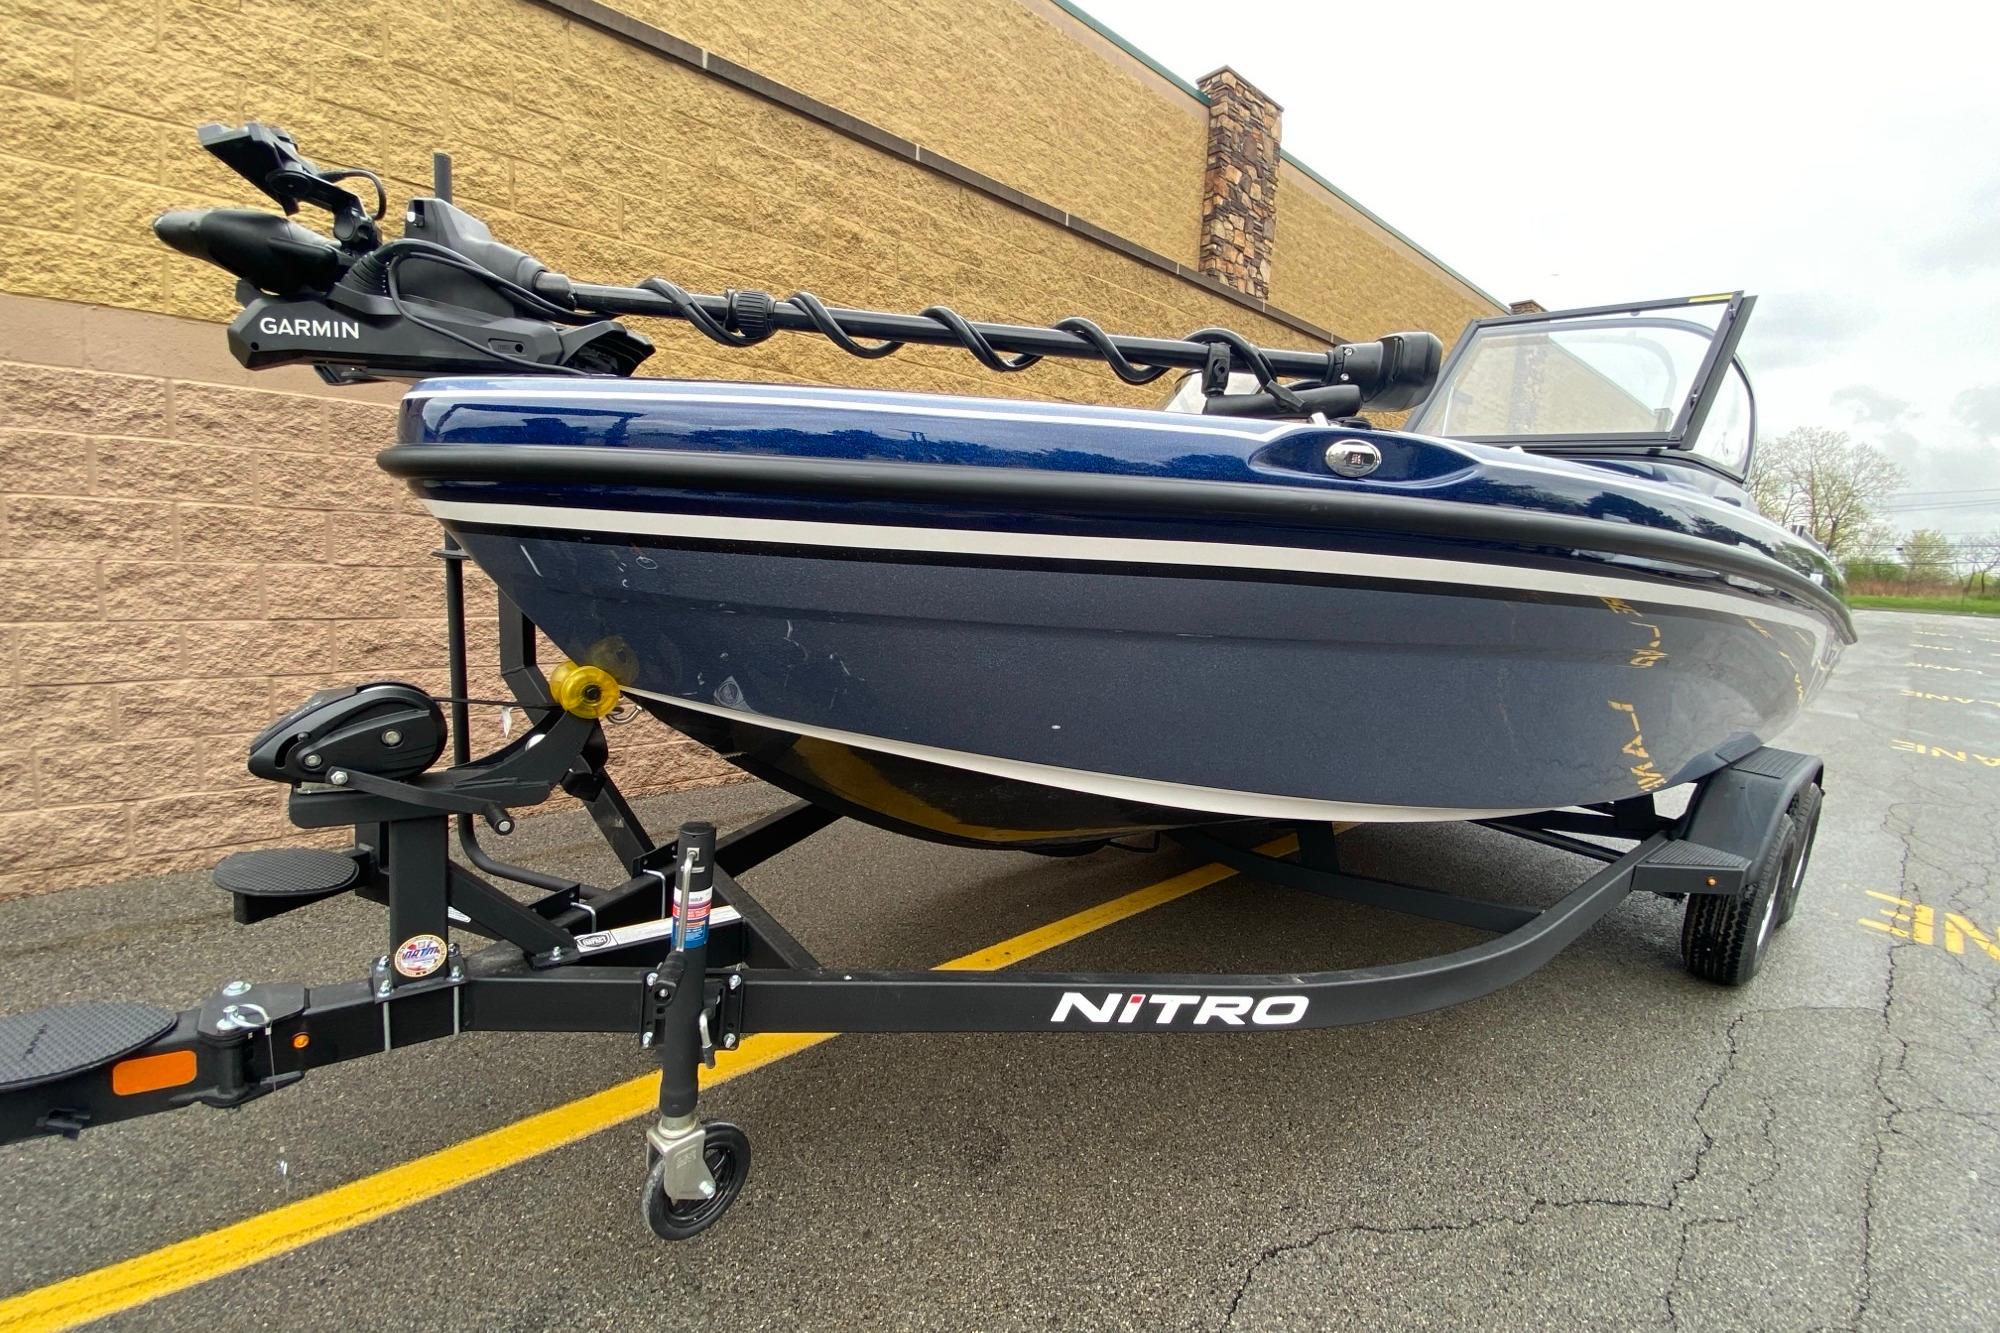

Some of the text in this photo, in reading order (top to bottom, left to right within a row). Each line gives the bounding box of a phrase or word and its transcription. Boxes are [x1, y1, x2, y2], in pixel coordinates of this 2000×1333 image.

[260, 317, 360, 340] GARMIN
[1891, 738, 2000, 767] ANE
[1857, 889, 2000, 961] NE
[1050, 992, 1310, 1025] NITRO
